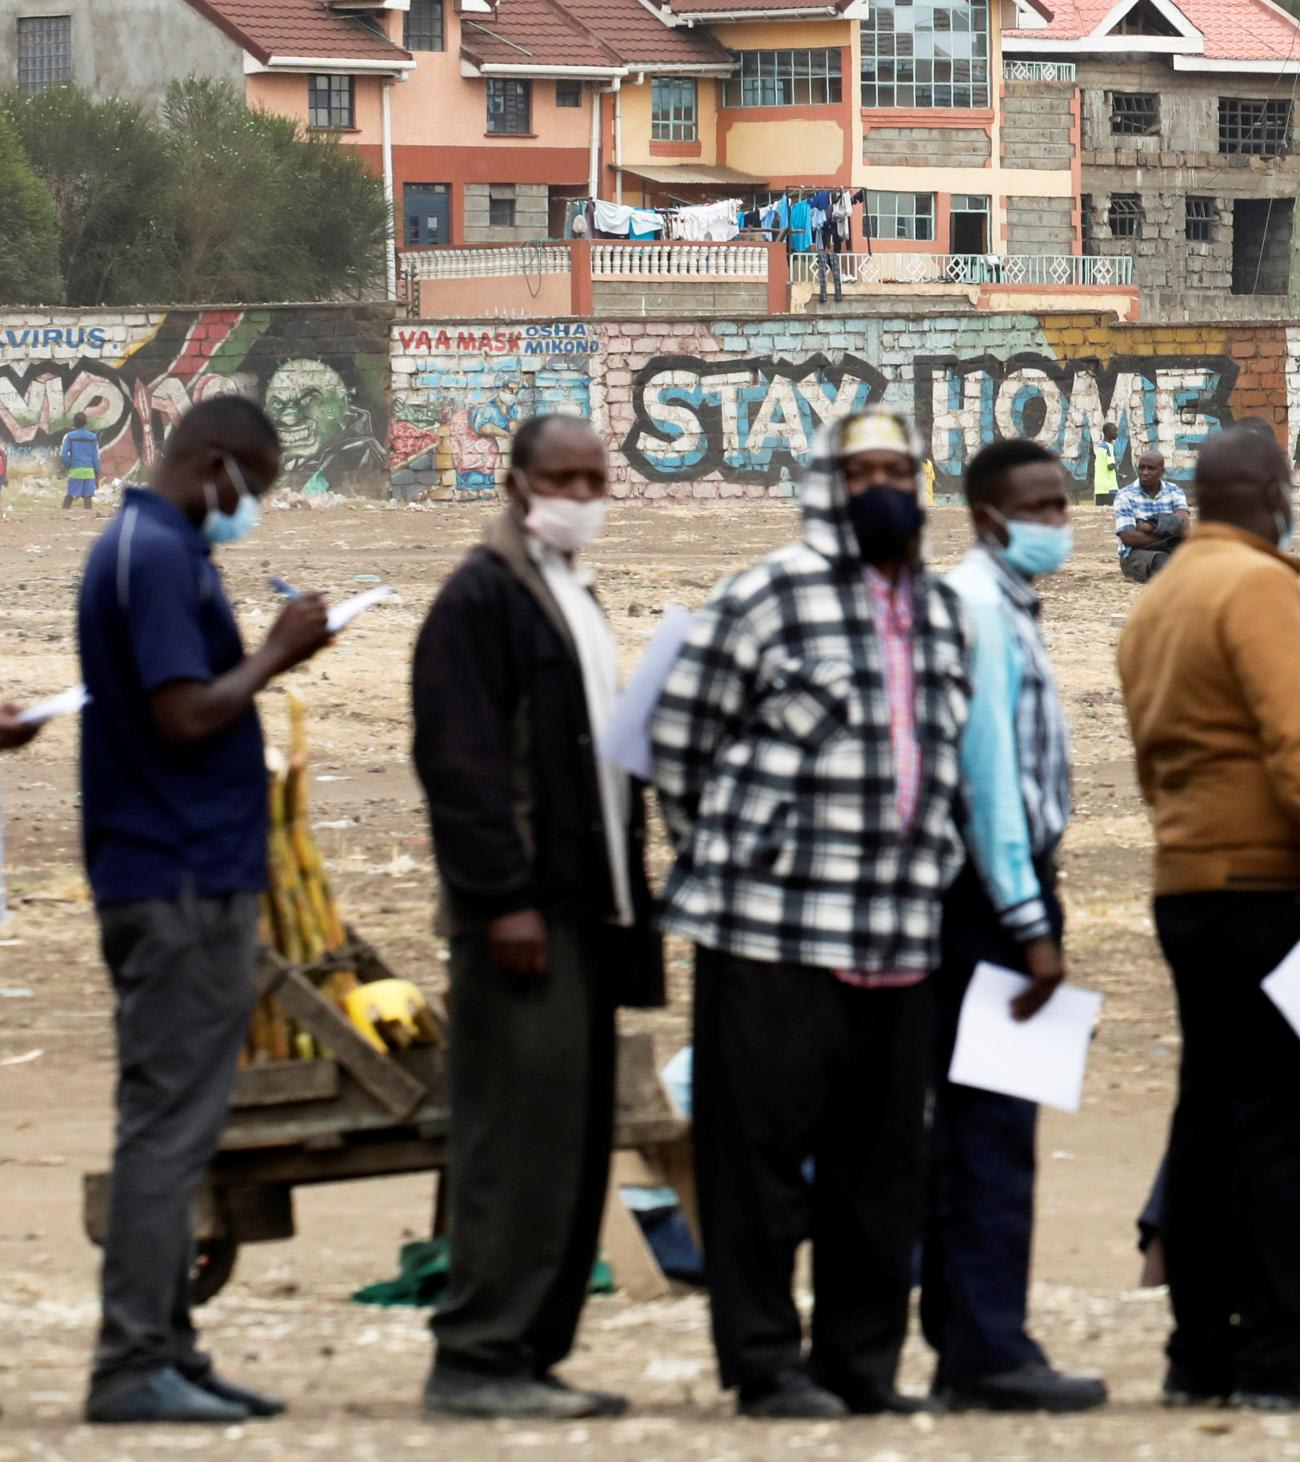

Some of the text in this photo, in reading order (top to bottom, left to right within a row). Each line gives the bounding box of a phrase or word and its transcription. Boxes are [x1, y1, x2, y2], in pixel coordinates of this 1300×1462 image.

[399, 330, 523, 352] VAA MASK
[525, 323, 588, 337] OSHA
[630, 362, 1224, 483] STAY HOME
